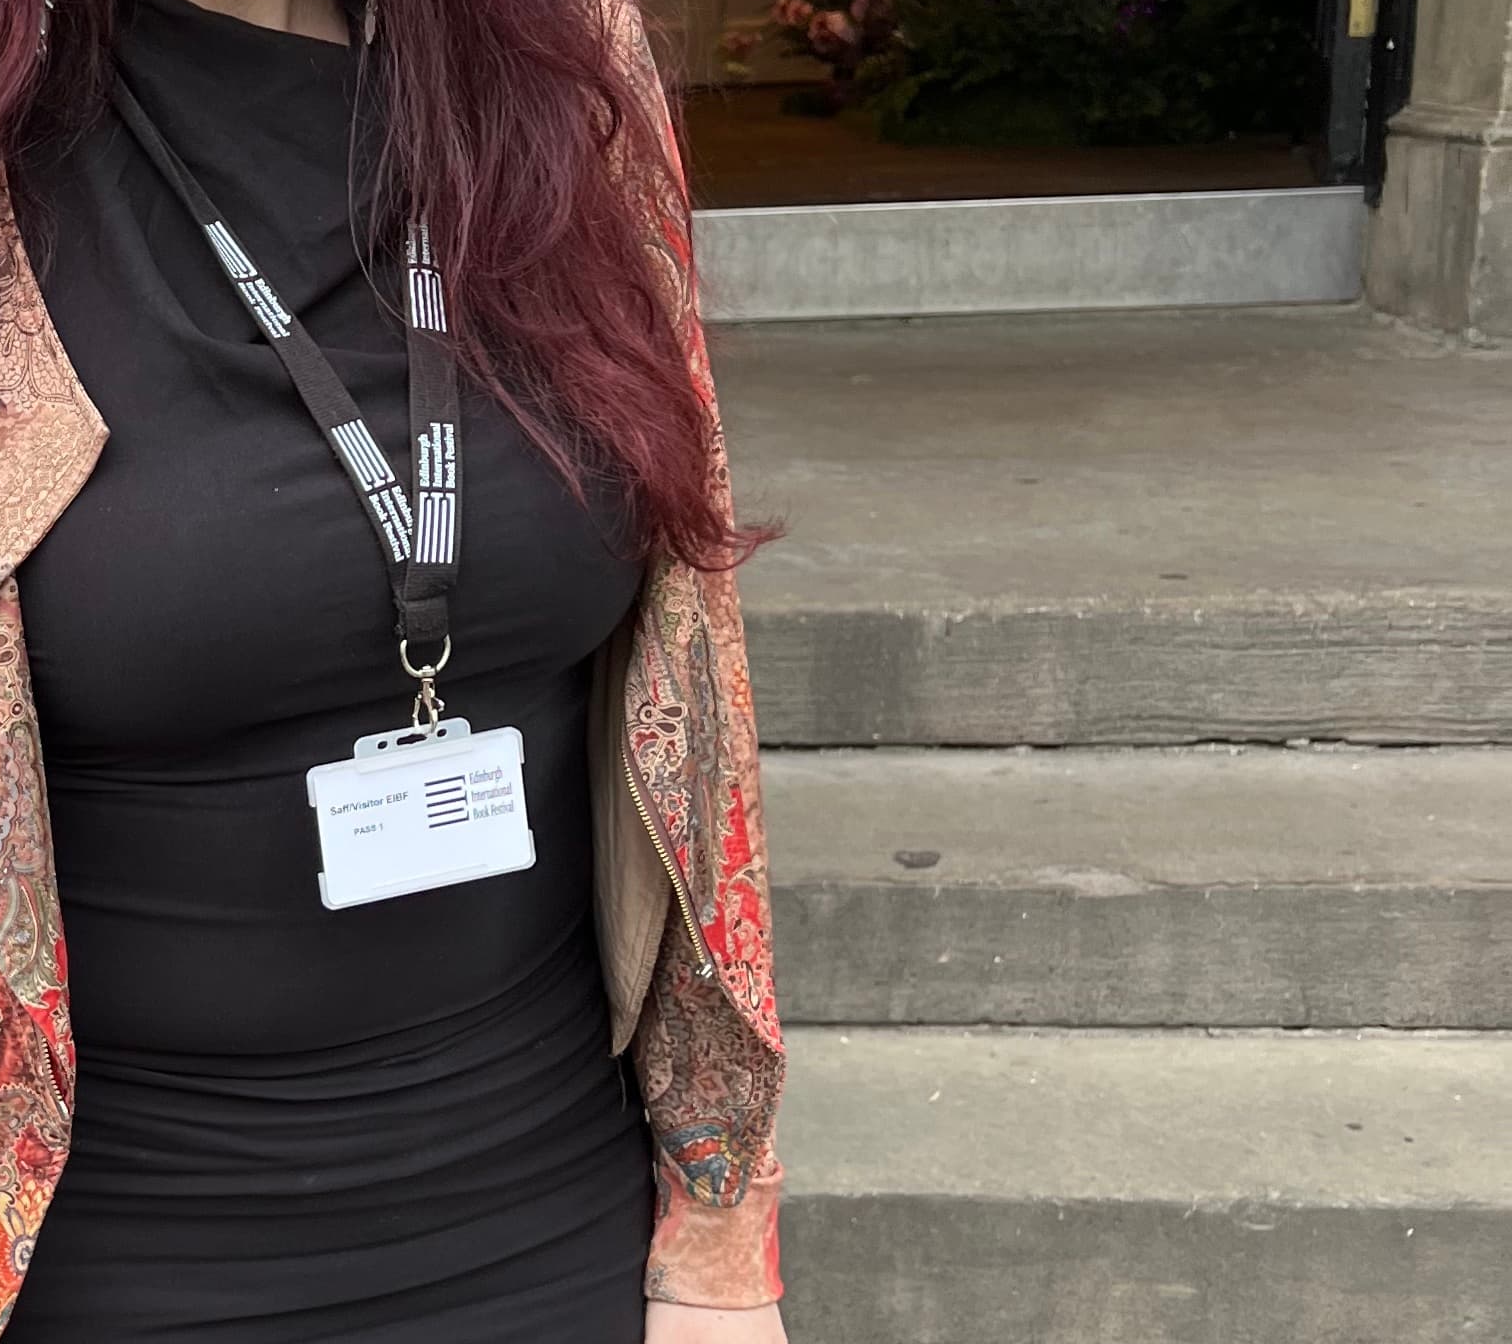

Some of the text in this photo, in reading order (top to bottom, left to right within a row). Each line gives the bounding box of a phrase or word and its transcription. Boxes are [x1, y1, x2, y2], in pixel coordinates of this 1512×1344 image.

[417, 433, 431, 488] Edinburgh
[429, 422, 443, 488] International
[442, 423, 456, 489] Book Festival
[368, 493, 405, 563] Book Festival
